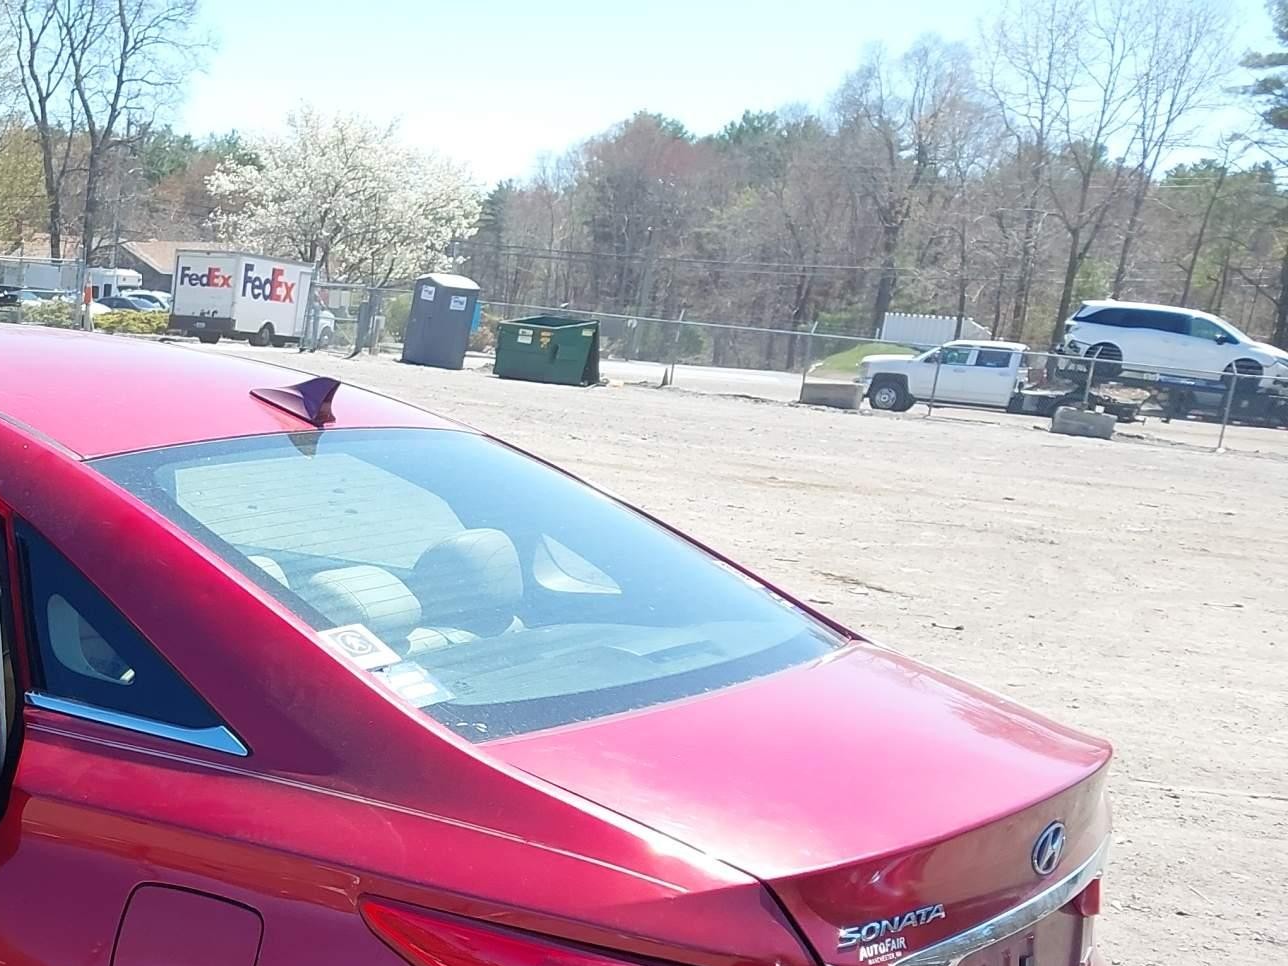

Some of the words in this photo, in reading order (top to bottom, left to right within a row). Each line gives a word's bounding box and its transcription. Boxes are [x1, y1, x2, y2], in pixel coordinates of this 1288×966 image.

[179, 266, 232, 288] FedEx
[241, 263, 296, 304] FedEx
[837, 903, 947, 948] SONATA
